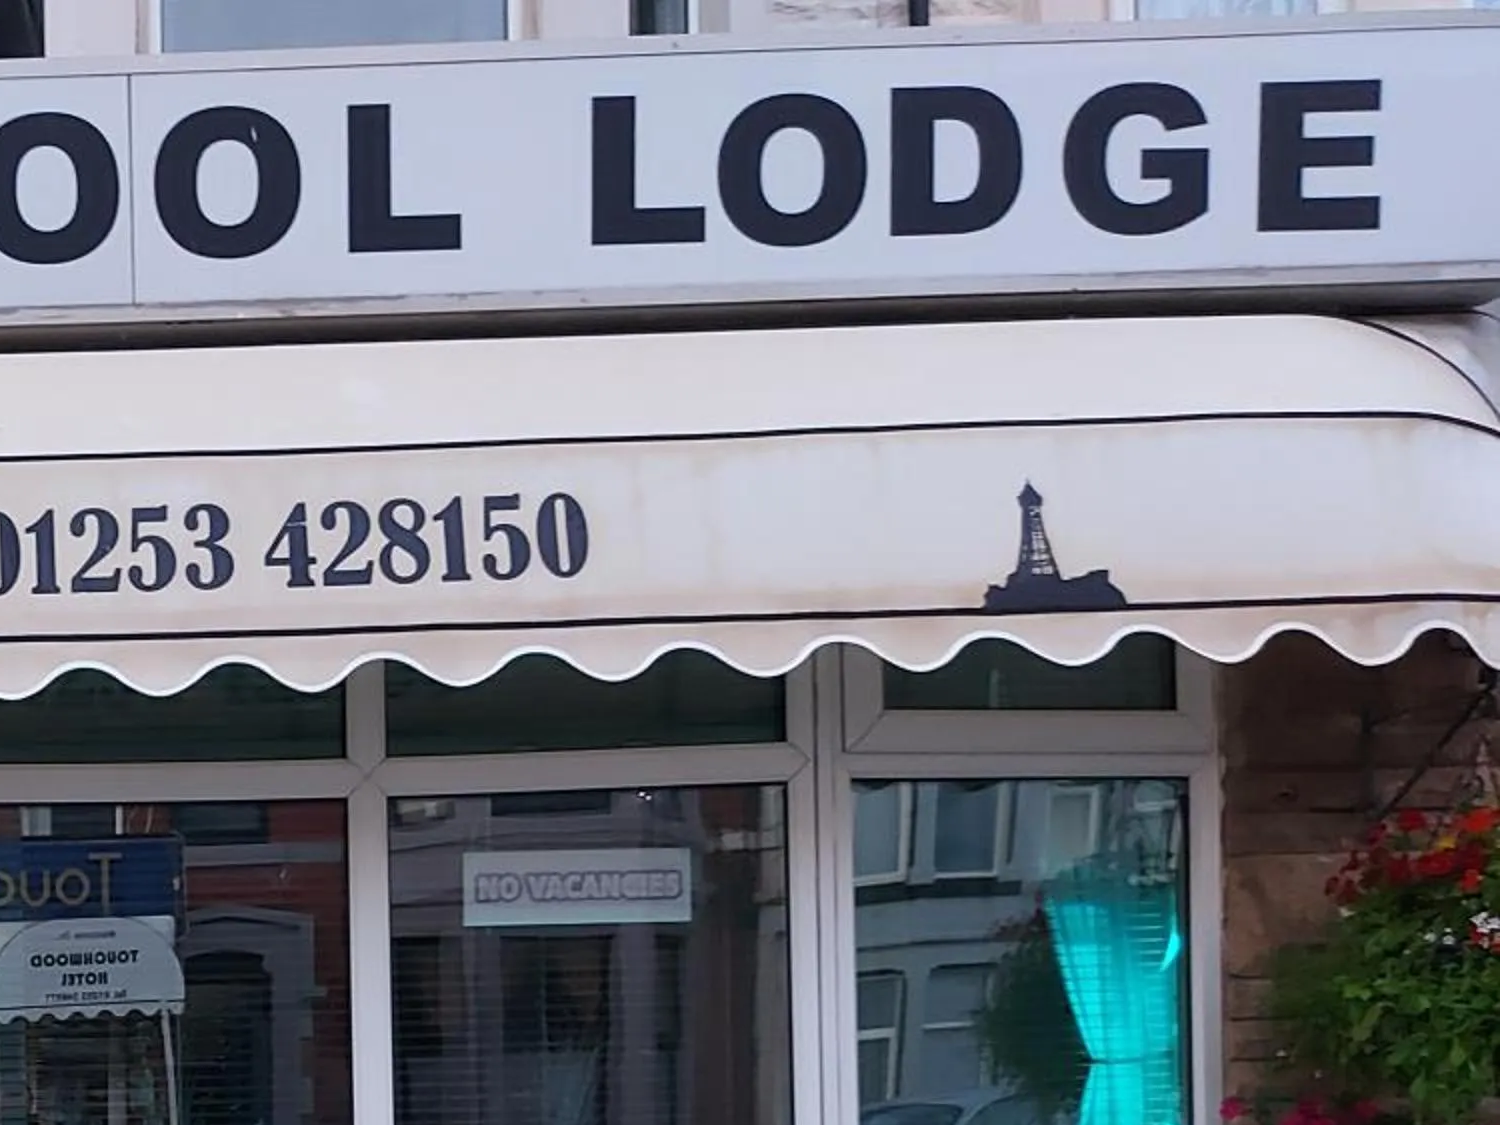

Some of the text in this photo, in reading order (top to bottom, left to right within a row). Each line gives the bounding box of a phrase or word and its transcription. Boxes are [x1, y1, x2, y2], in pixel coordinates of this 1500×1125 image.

[591, 79, 1383, 247] LODGE
[265, 492, 590, 589] 428150
[475, 869, 683, 903] NO VACANCIES
